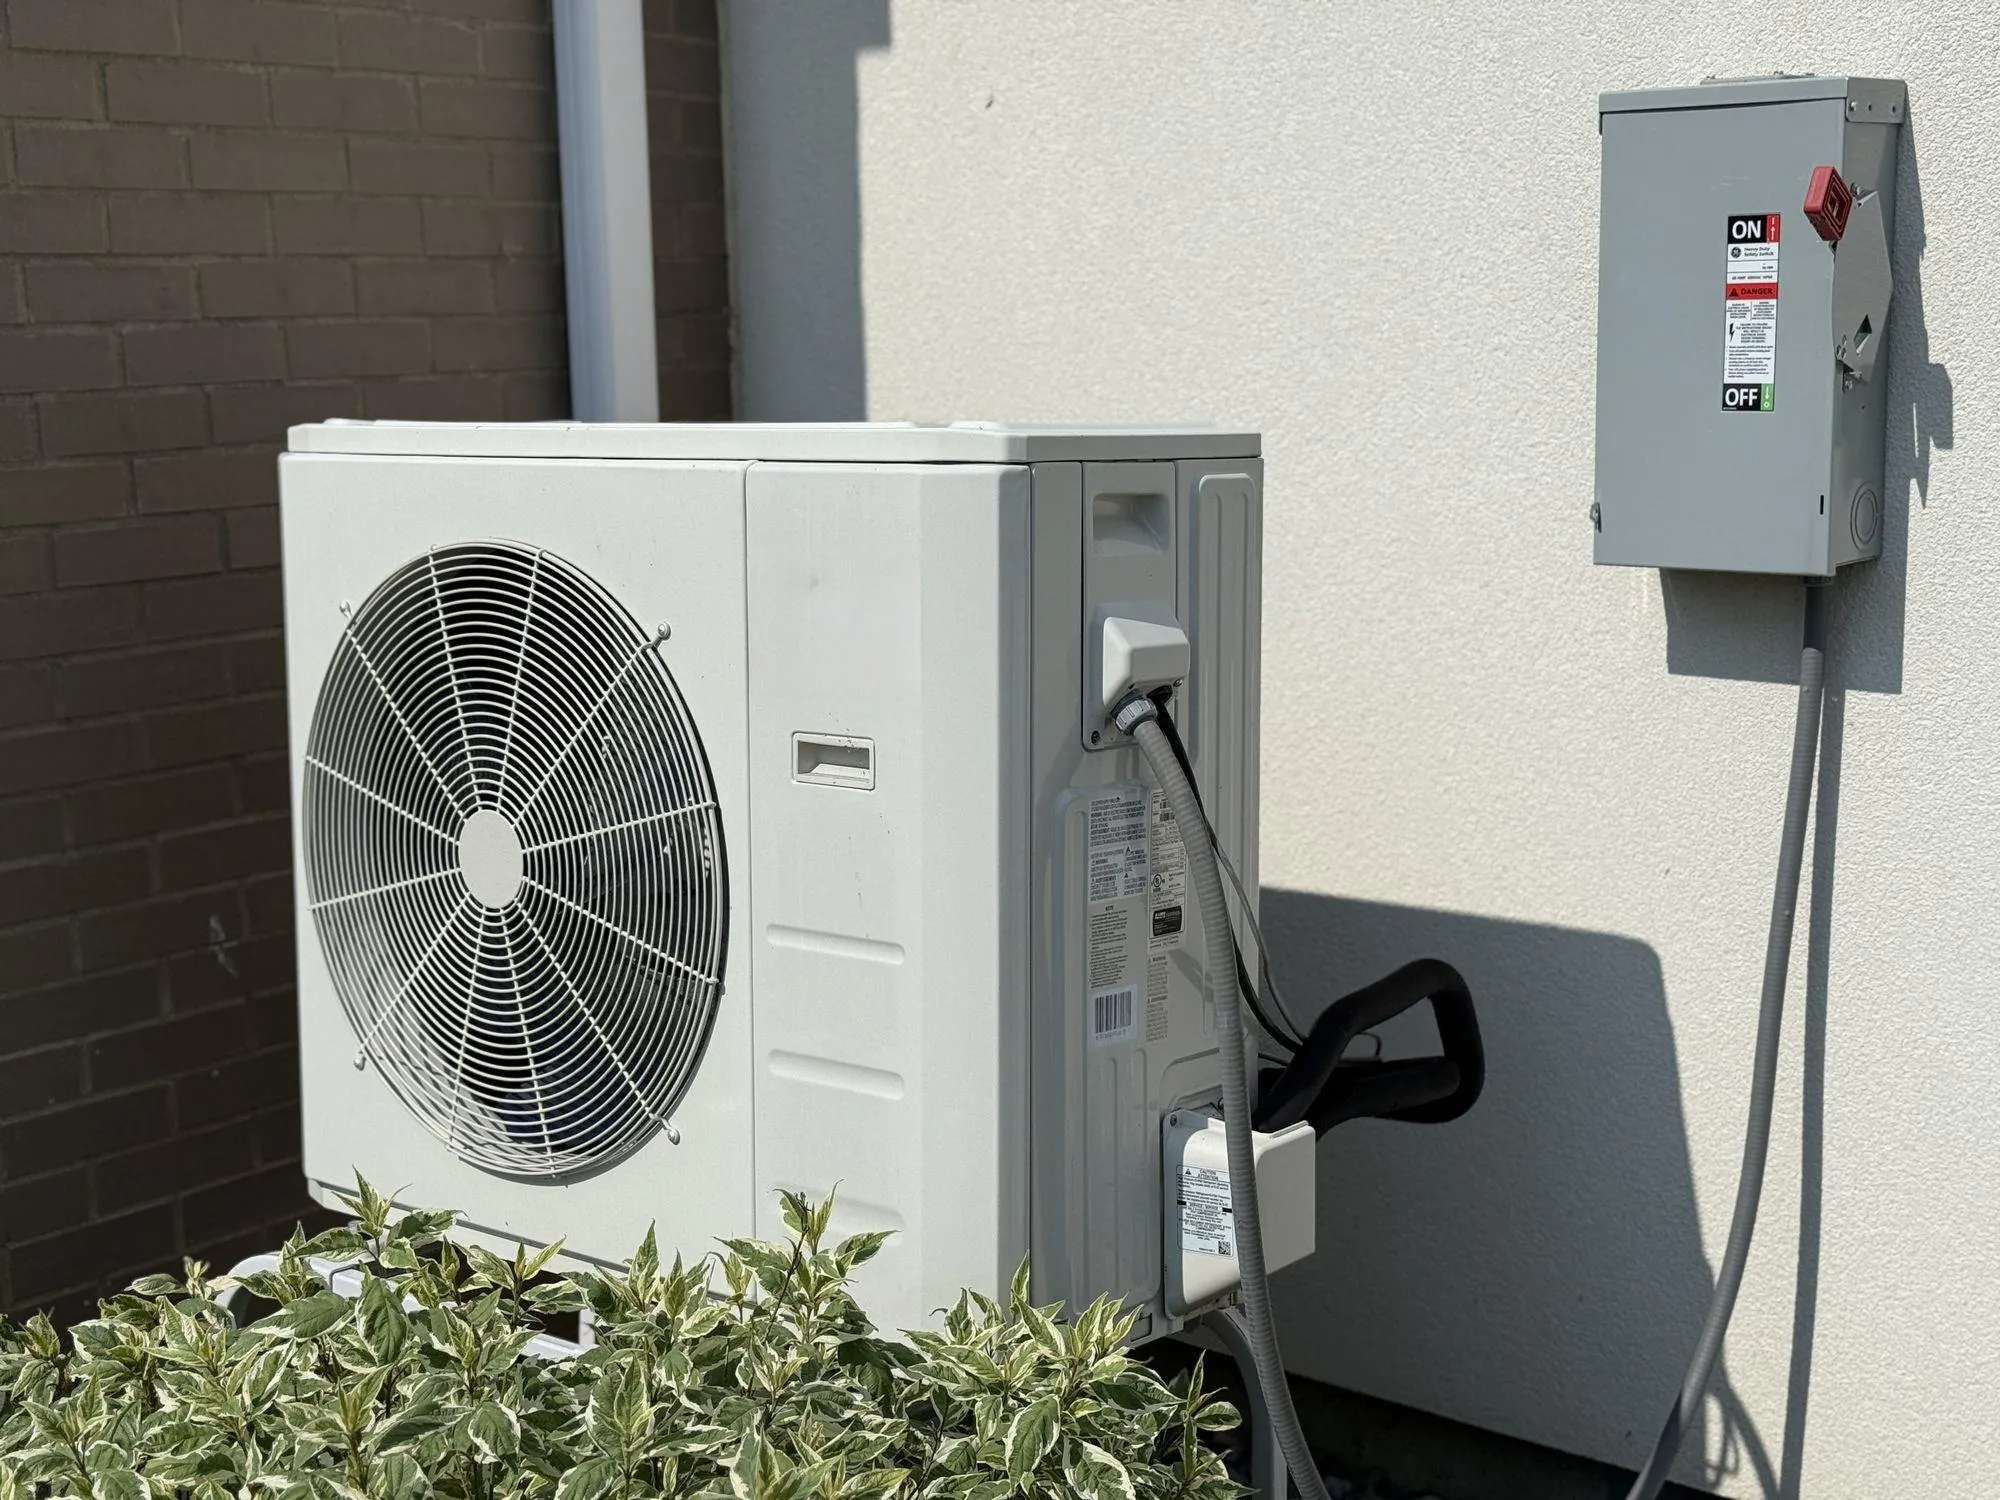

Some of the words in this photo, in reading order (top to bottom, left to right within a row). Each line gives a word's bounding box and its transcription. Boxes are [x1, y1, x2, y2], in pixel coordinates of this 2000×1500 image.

[1732, 220, 1762, 239] ON
[1740, 287, 1773, 295] DANGER
[1725, 388, 1758, 406] OFF
